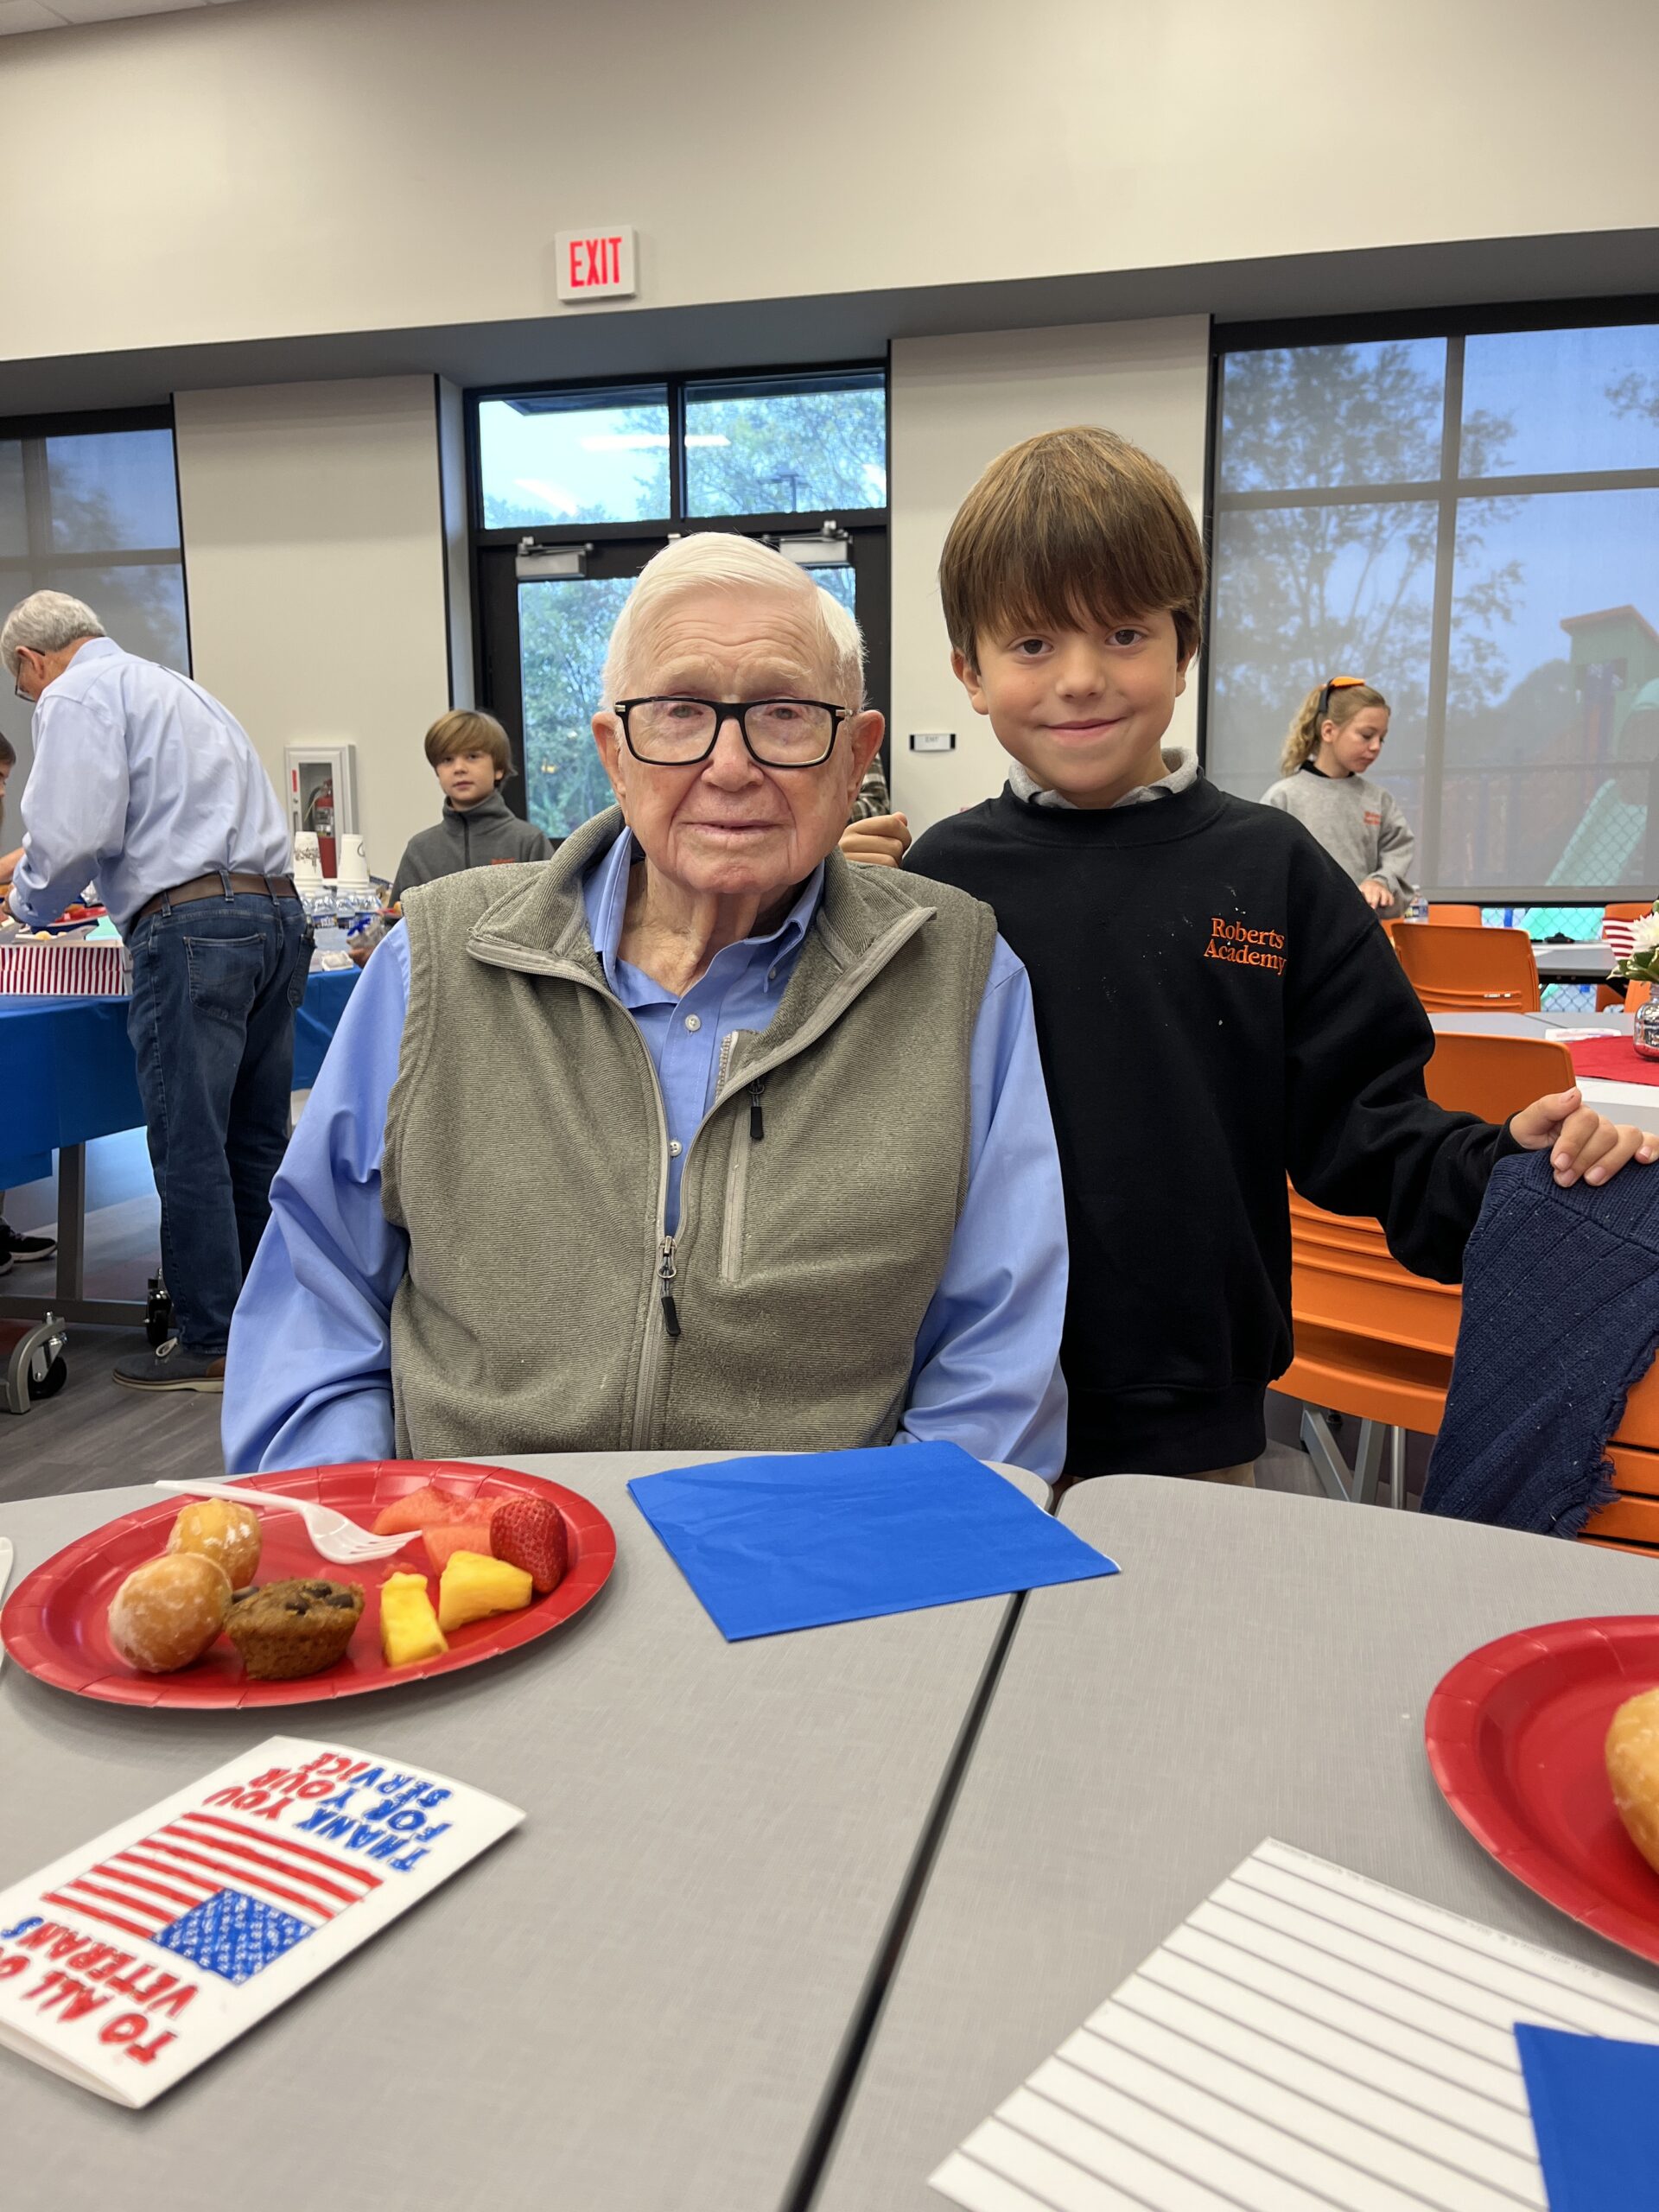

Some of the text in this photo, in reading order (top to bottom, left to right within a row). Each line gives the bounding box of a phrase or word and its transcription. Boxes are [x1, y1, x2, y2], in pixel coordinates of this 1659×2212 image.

[569, 237, 622, 289] EXIT
[1203, 938, 1287, 976] Academy
[1211, 917, 1286, 950] Roberts
[201, 1786, 430, 1872] THANK YOU
[248, 1768, 453, 1843] FOR YOUR
[1, 1916, 199, 2019] VETERANS
[20, 1969, 114, 2023] ALL
[98, 2012, 178, 2065] TO
